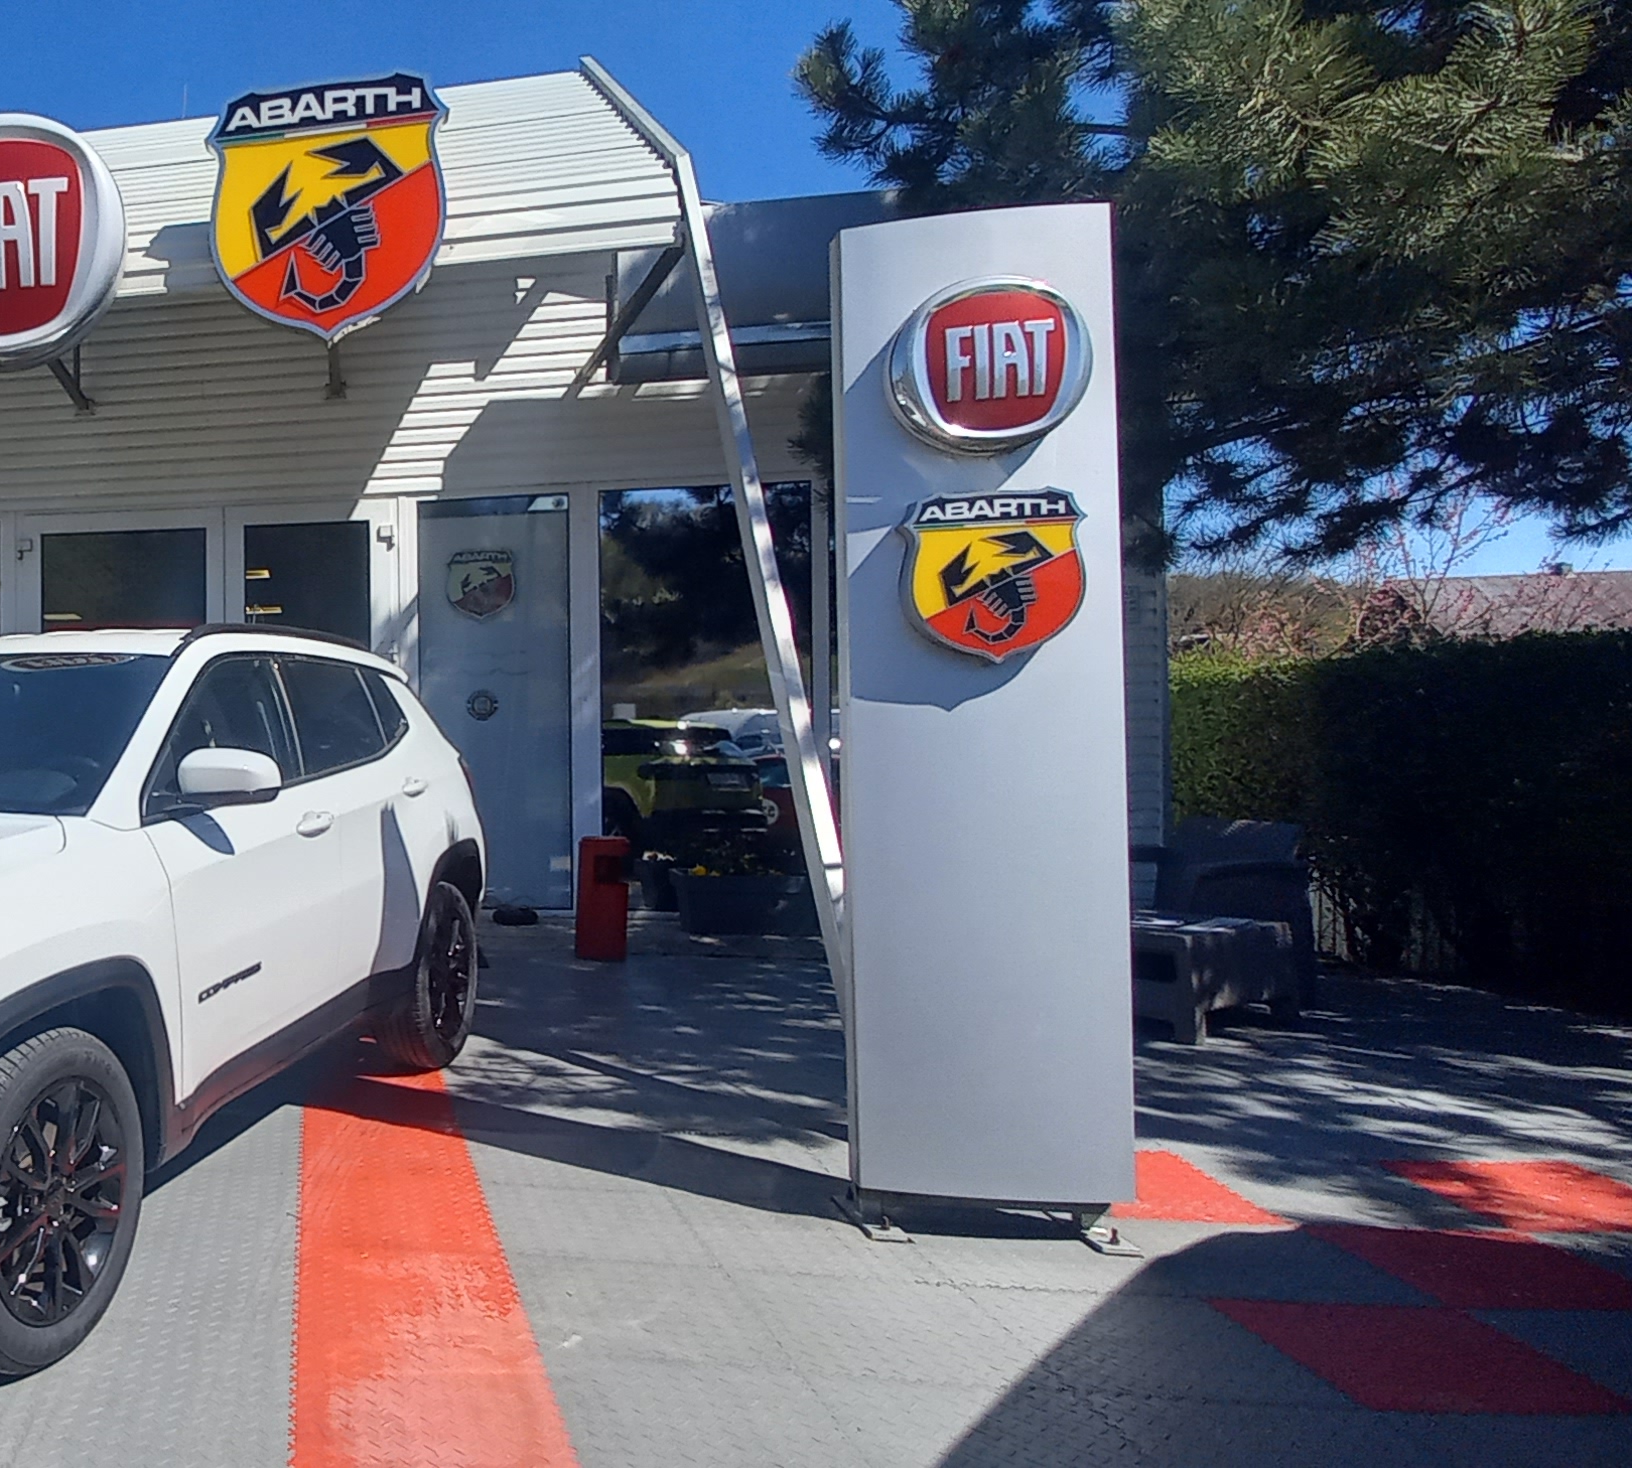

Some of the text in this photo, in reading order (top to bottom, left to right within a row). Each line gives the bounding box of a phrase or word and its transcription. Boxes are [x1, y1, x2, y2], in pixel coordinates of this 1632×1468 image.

[225, 85, 422, 132] ABARTH
[943, 318, 1056, 402] FIAT
[919, 498, 1067, 522] ABARTH
